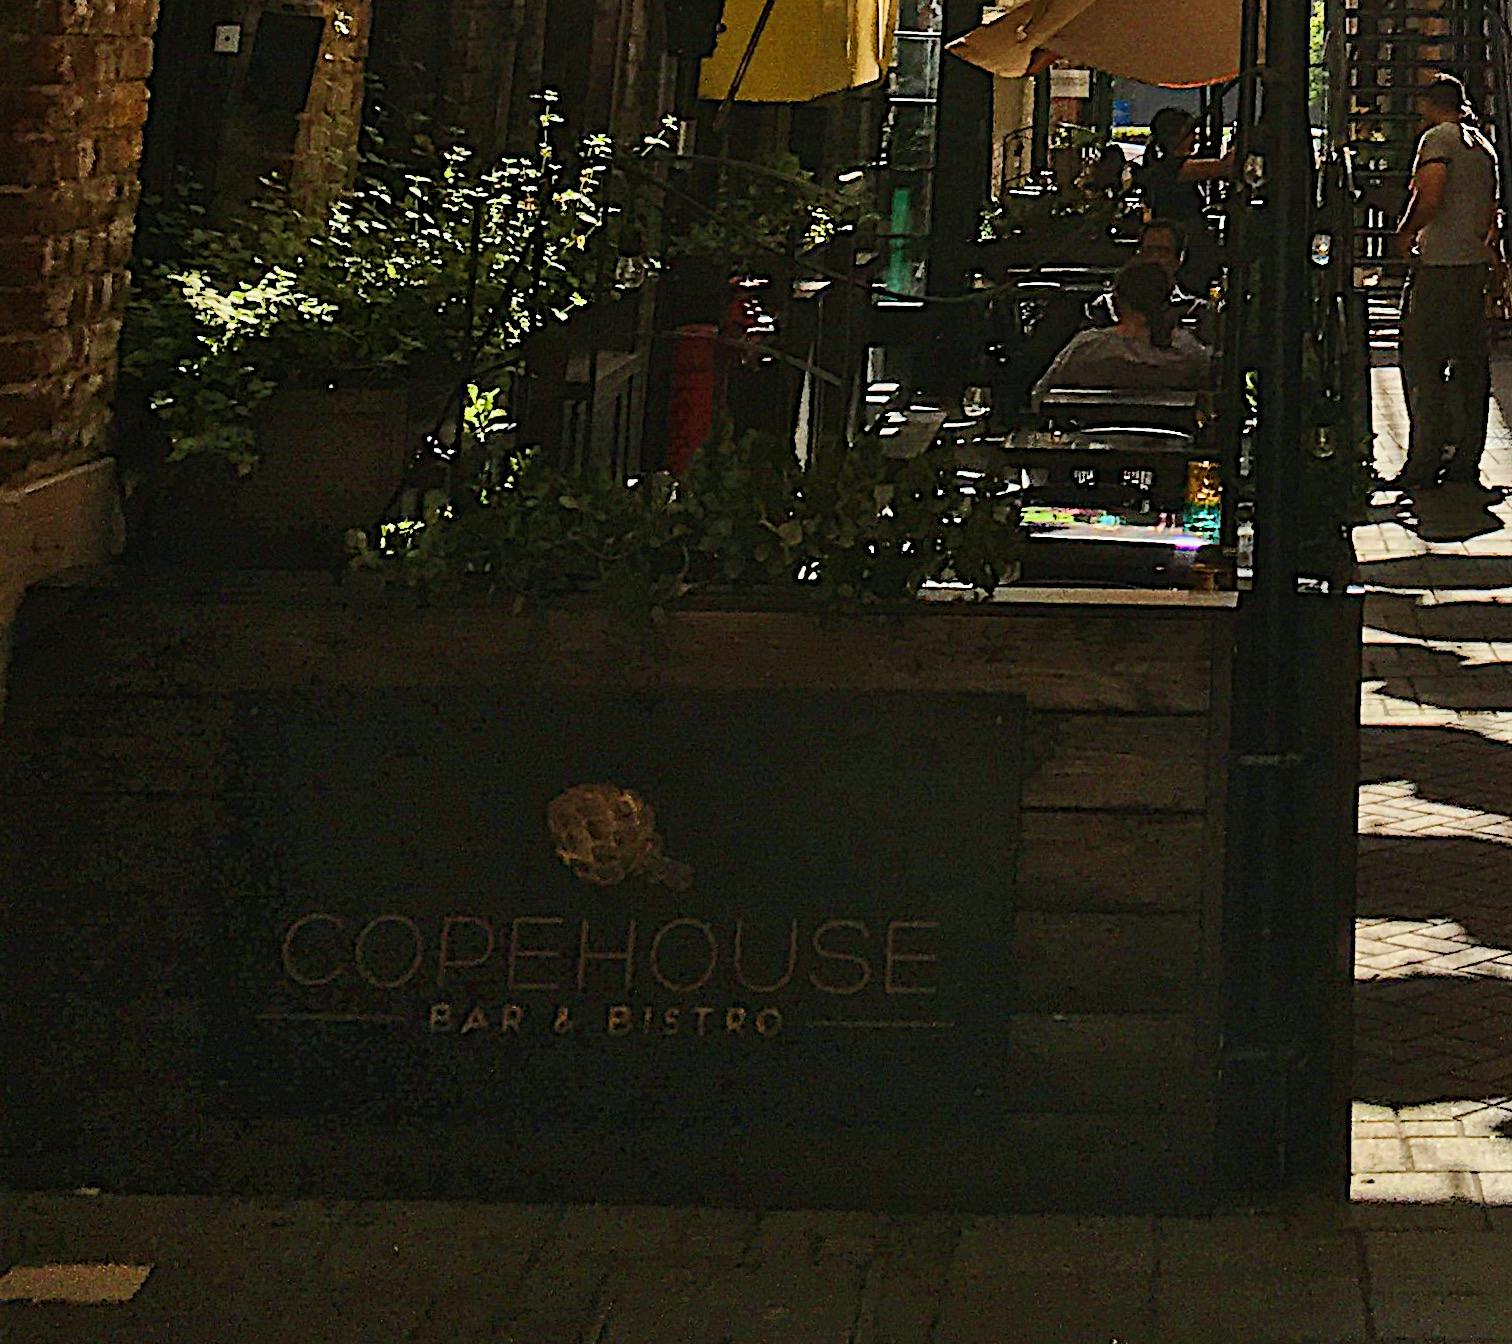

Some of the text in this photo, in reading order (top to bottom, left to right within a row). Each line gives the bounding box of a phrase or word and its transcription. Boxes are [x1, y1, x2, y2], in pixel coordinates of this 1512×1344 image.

[281, 912, 937, 994] COPEHOUSE
[427, 1001, 785, 1038] BAR & BISTRO
